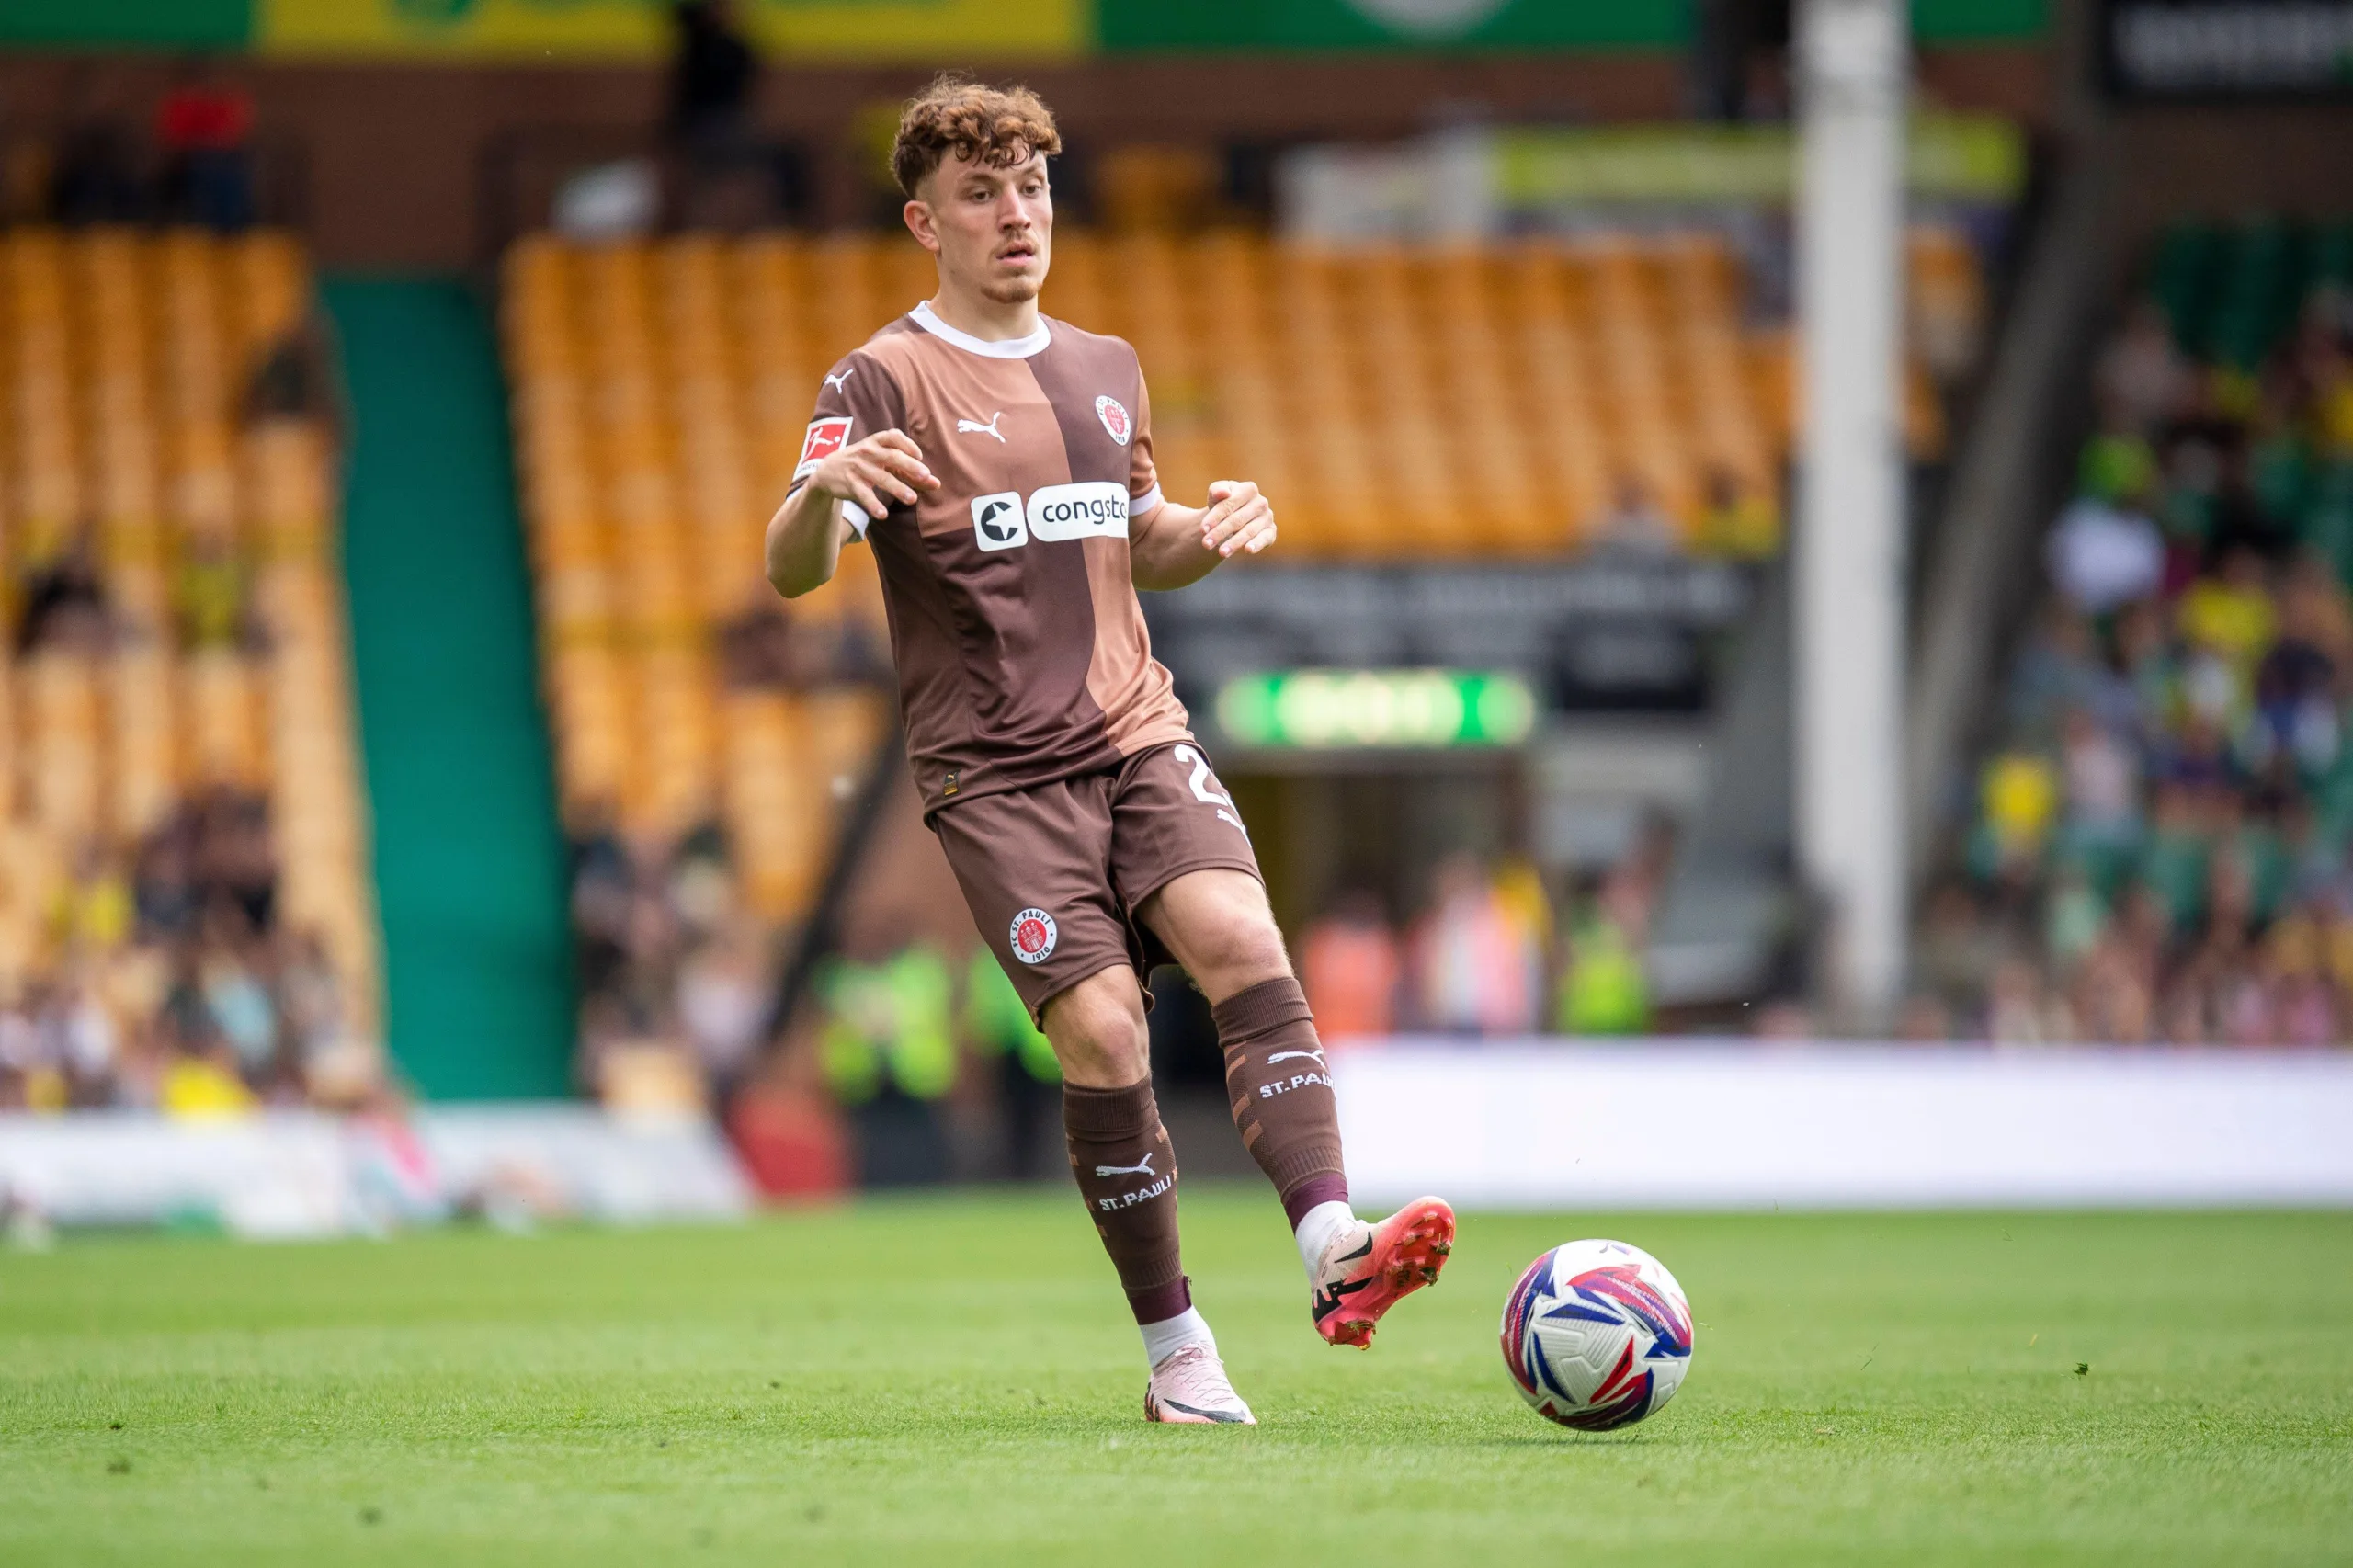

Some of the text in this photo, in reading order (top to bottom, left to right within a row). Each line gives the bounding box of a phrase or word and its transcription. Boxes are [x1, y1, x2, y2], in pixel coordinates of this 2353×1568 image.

[1174, 744, 1239, 817] 2
[1011, 910, 1051, 948] FC ST. PAULI
[1032, 946, 1051, 962] 1910
